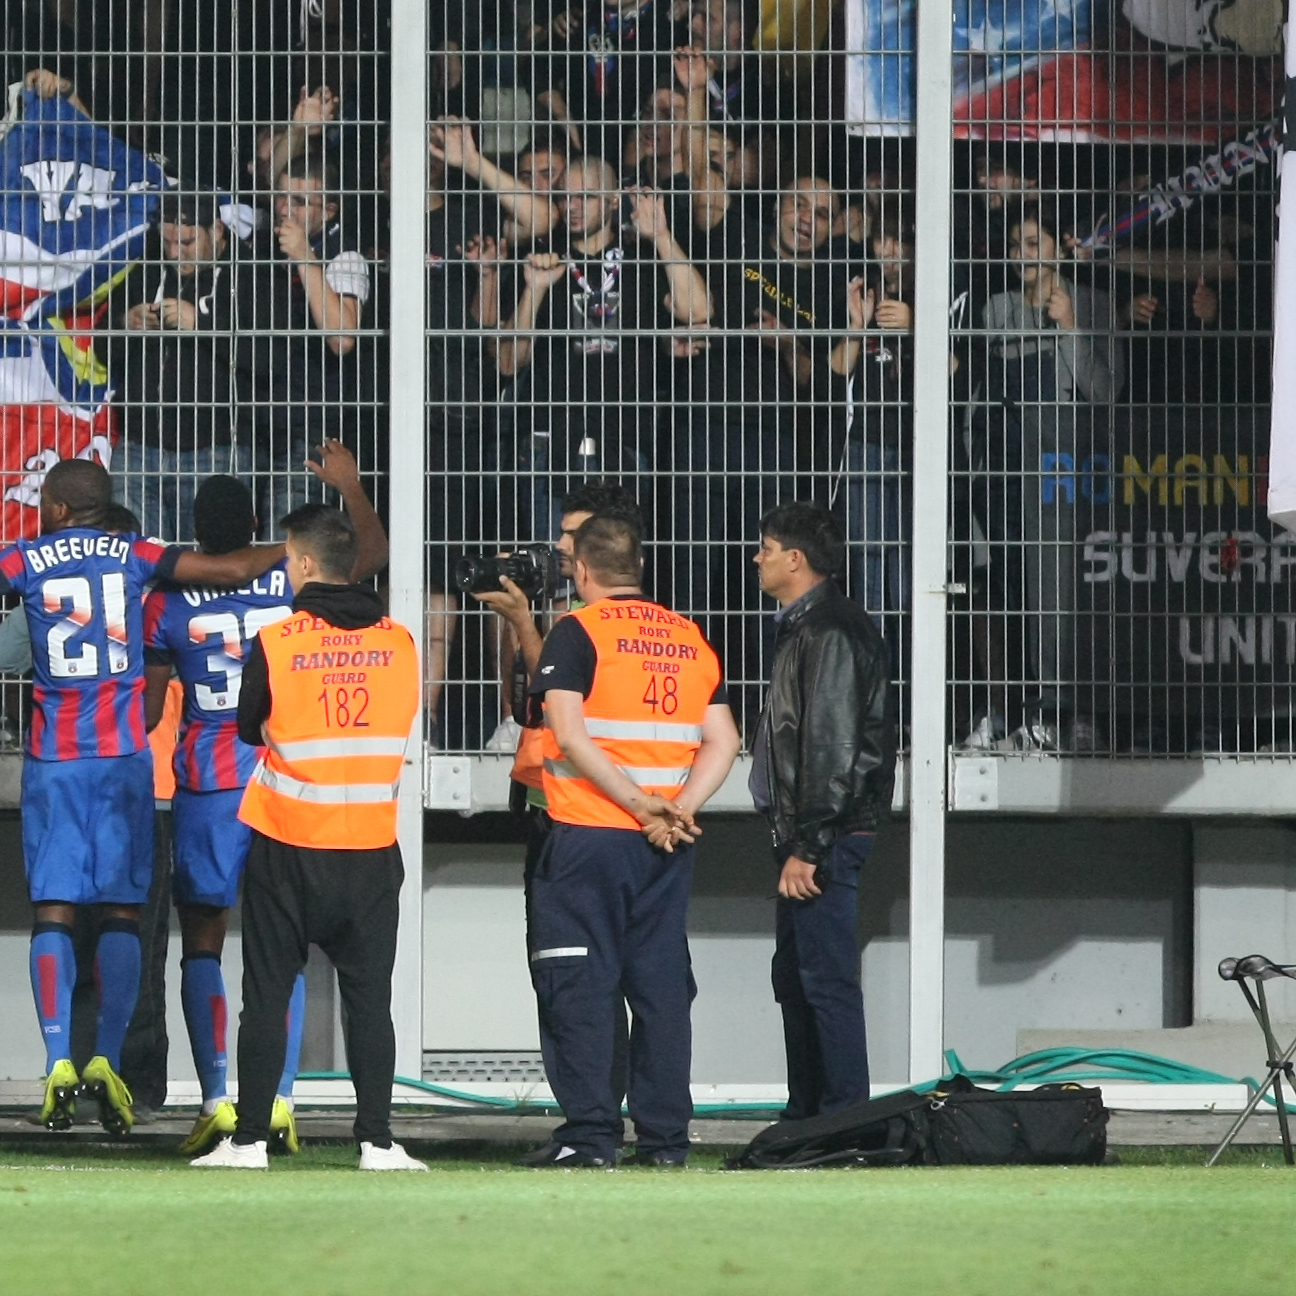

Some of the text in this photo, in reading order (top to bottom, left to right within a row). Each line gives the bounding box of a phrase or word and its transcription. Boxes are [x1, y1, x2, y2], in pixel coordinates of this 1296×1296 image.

[42, 572, 129, 678] 21
[599, 605, 690, 630] STEWARD
[290, 650, 394, 671] RANDORY
[616, 638, 698, 661] RANDORY
[322, 672, 367, 685] GUARD
[642, 660, 680, 674] GUARD
[642, 674, 678, 715] 48
[318, 686, 369, 728] 182
